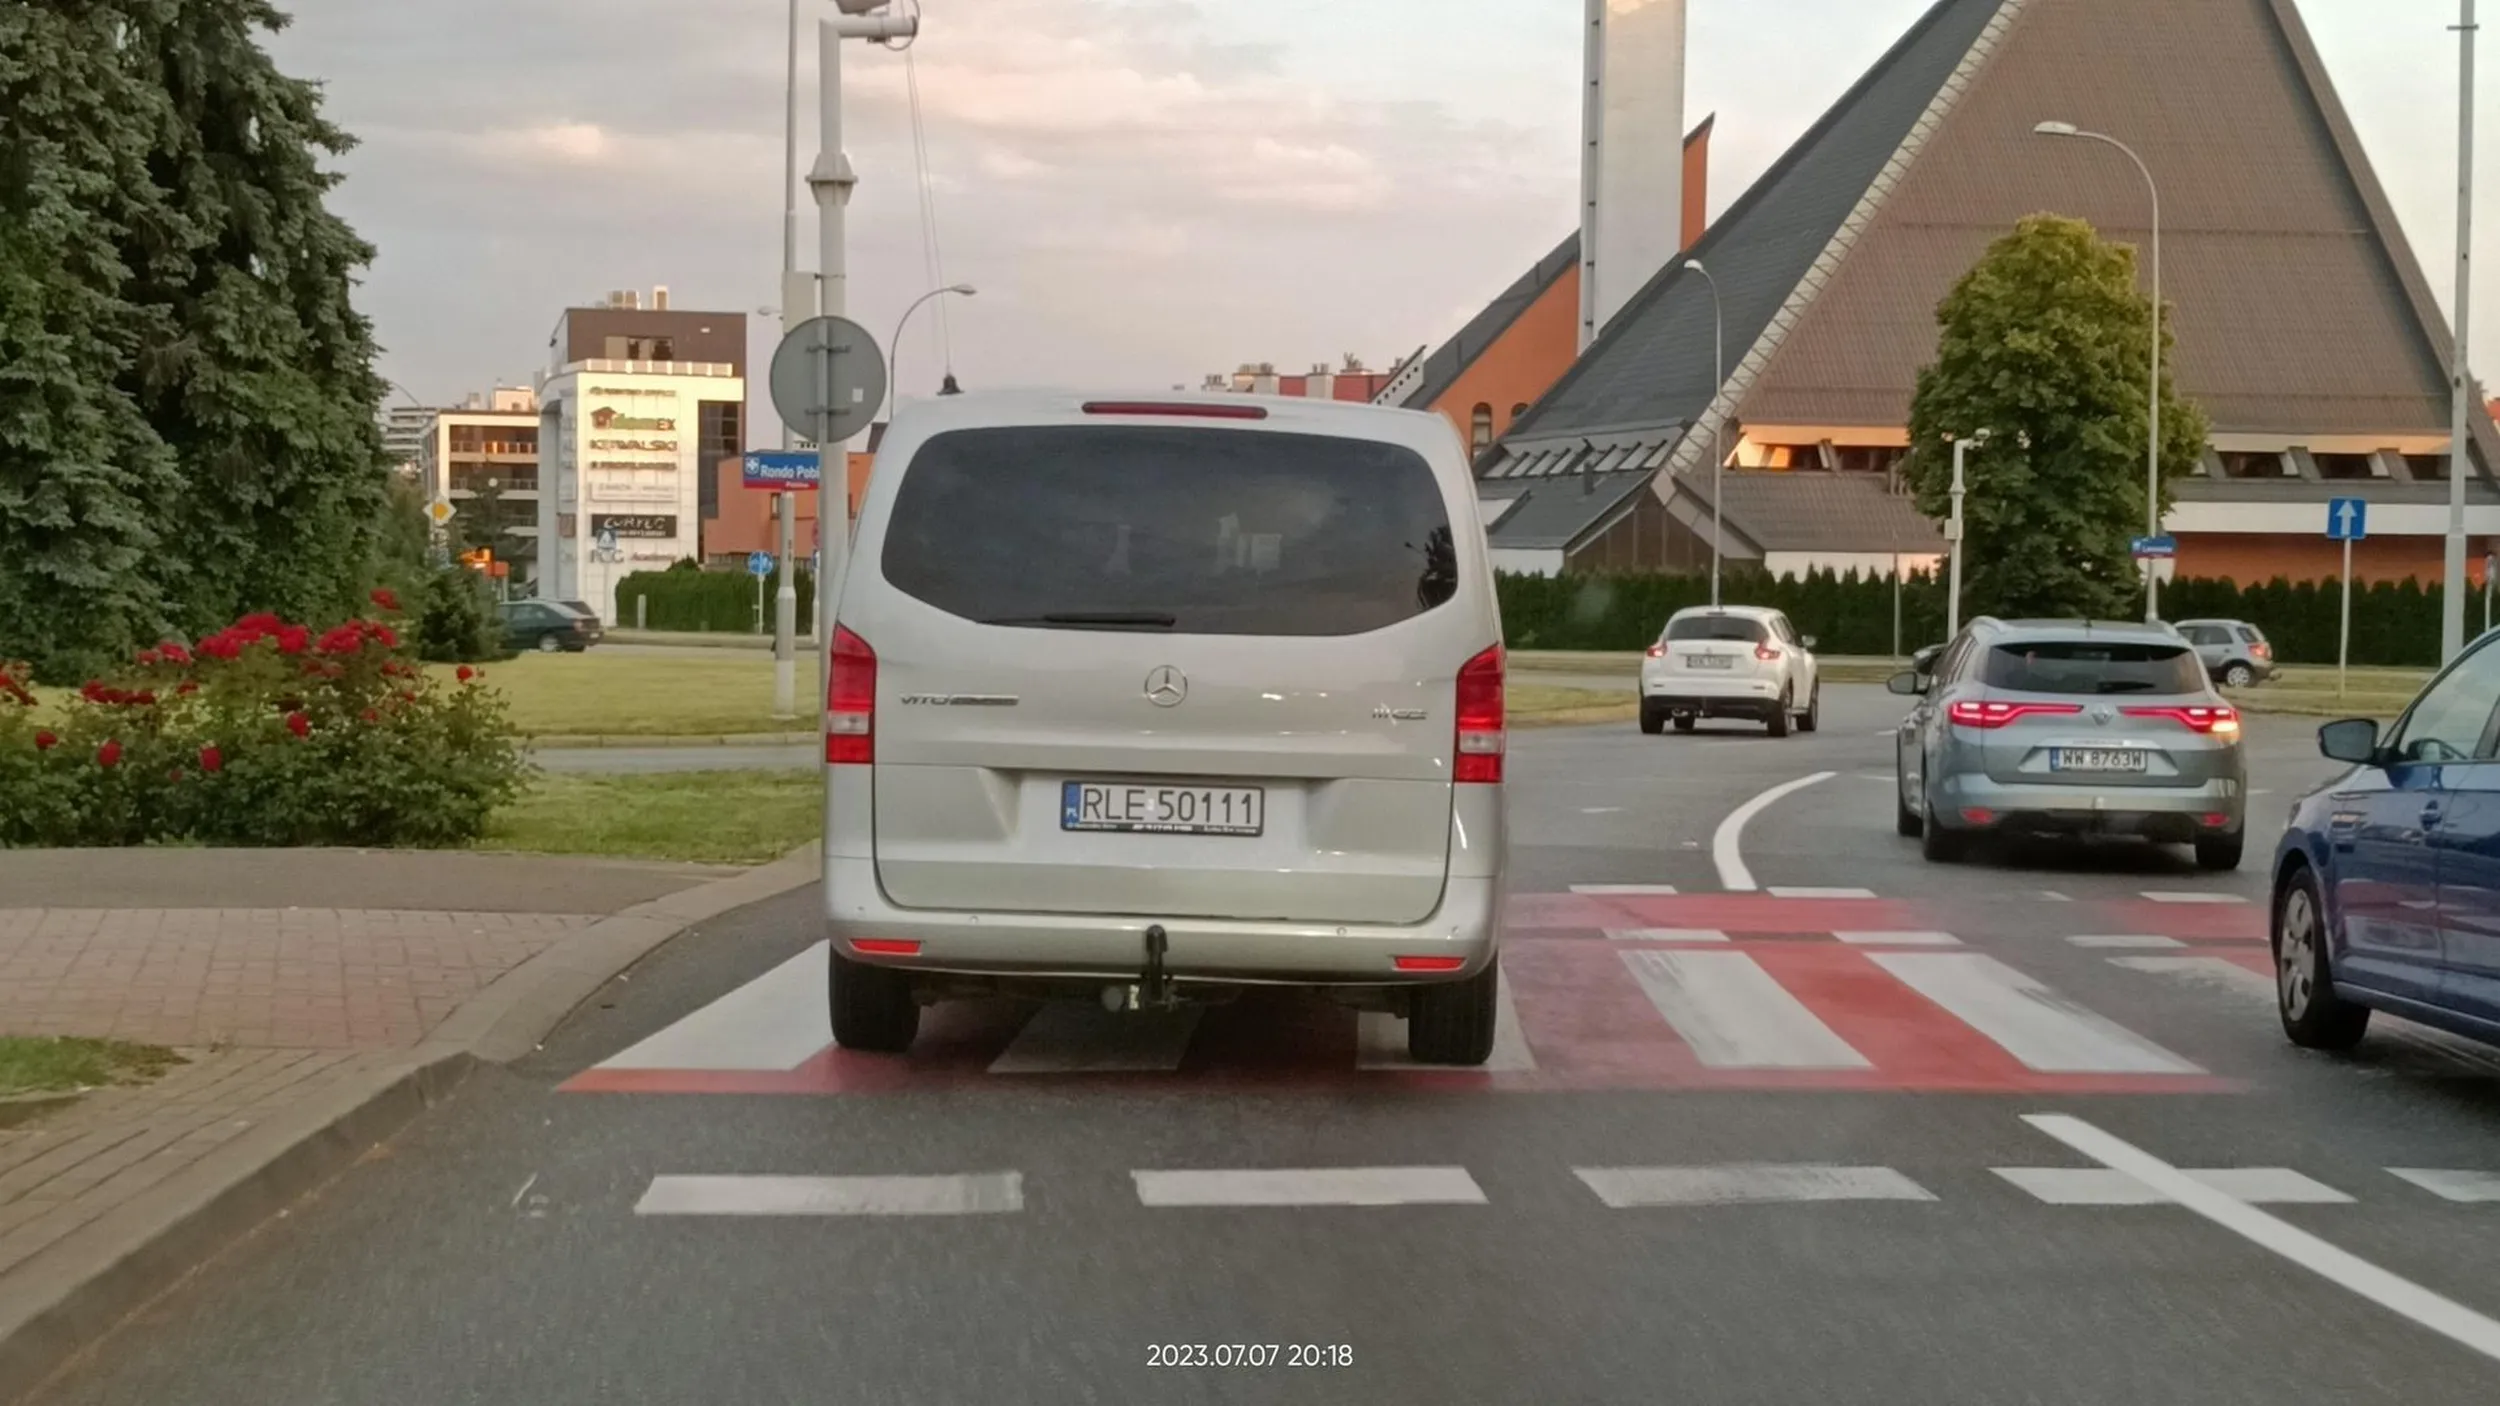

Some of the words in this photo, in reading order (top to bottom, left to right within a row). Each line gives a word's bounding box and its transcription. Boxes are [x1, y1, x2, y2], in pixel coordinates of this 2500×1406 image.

[760, 464, 795, 479] Rondo
[900, 693, 949, 707] VITO
[2062, 749, 2085, 766] WW
[2090, 750, 2143, 767] 8763W
[1083, 788, 1146, 821] RLE
[1157, 790, 1253, 825] 50111
